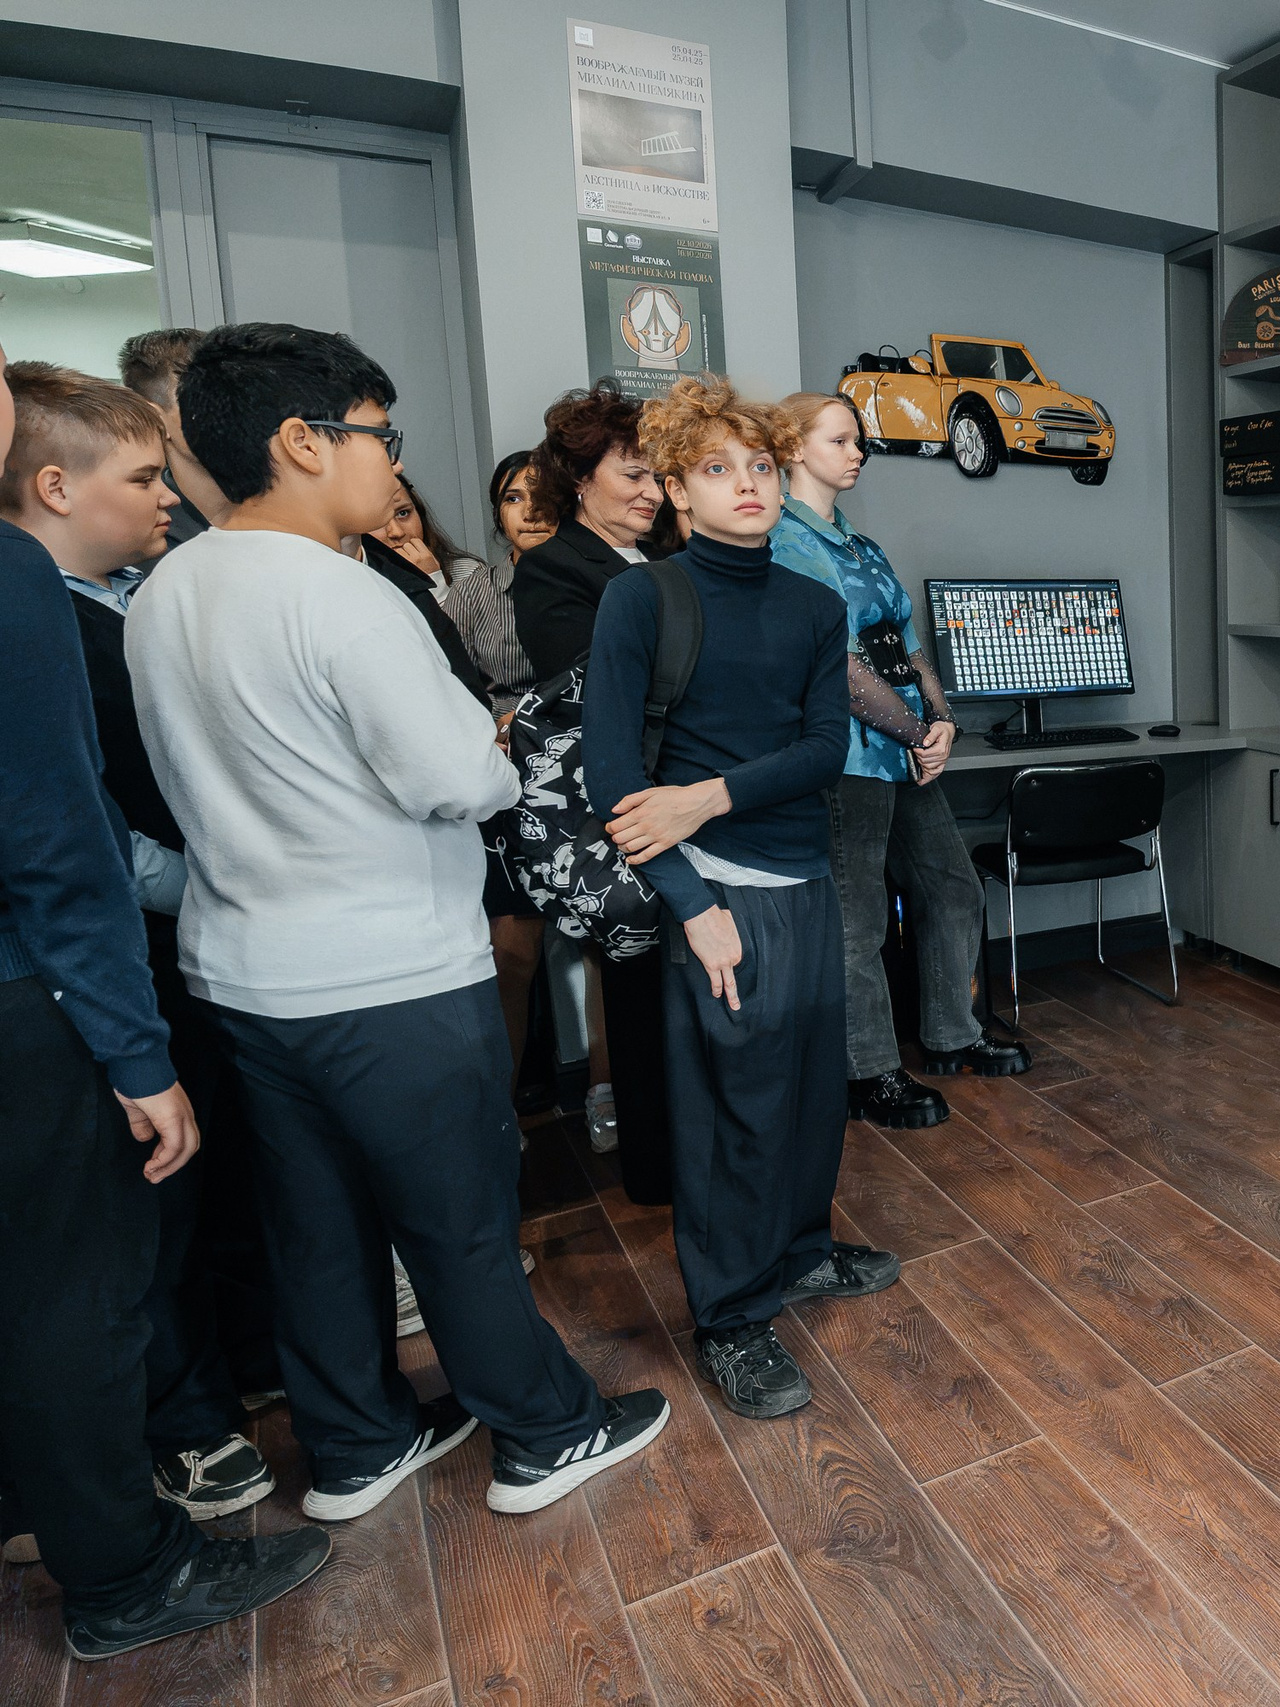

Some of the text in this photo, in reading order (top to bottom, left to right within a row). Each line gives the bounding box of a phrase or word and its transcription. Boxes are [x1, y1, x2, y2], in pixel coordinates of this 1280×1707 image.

[576, 56, 704, 88] ВООБРАЖАЕМЫЙ МУЗЕЙ
[577, 71, 705, 104] МИХАИЛА ШЕМЯКИНА
[583, 174, 642, 193] ЛЕСТНИЦА
[652, 184, 710, 201] ИСКУССТВЕ
[589, 260, 714, 284] МЕТАФИЗИЧЕСКАЯ ГОЛОВА
[632, 254, 672, 267] ВЫСТАВКА
[614, 369, 677, 381] ВООБРАЖАЕМЫЙ
